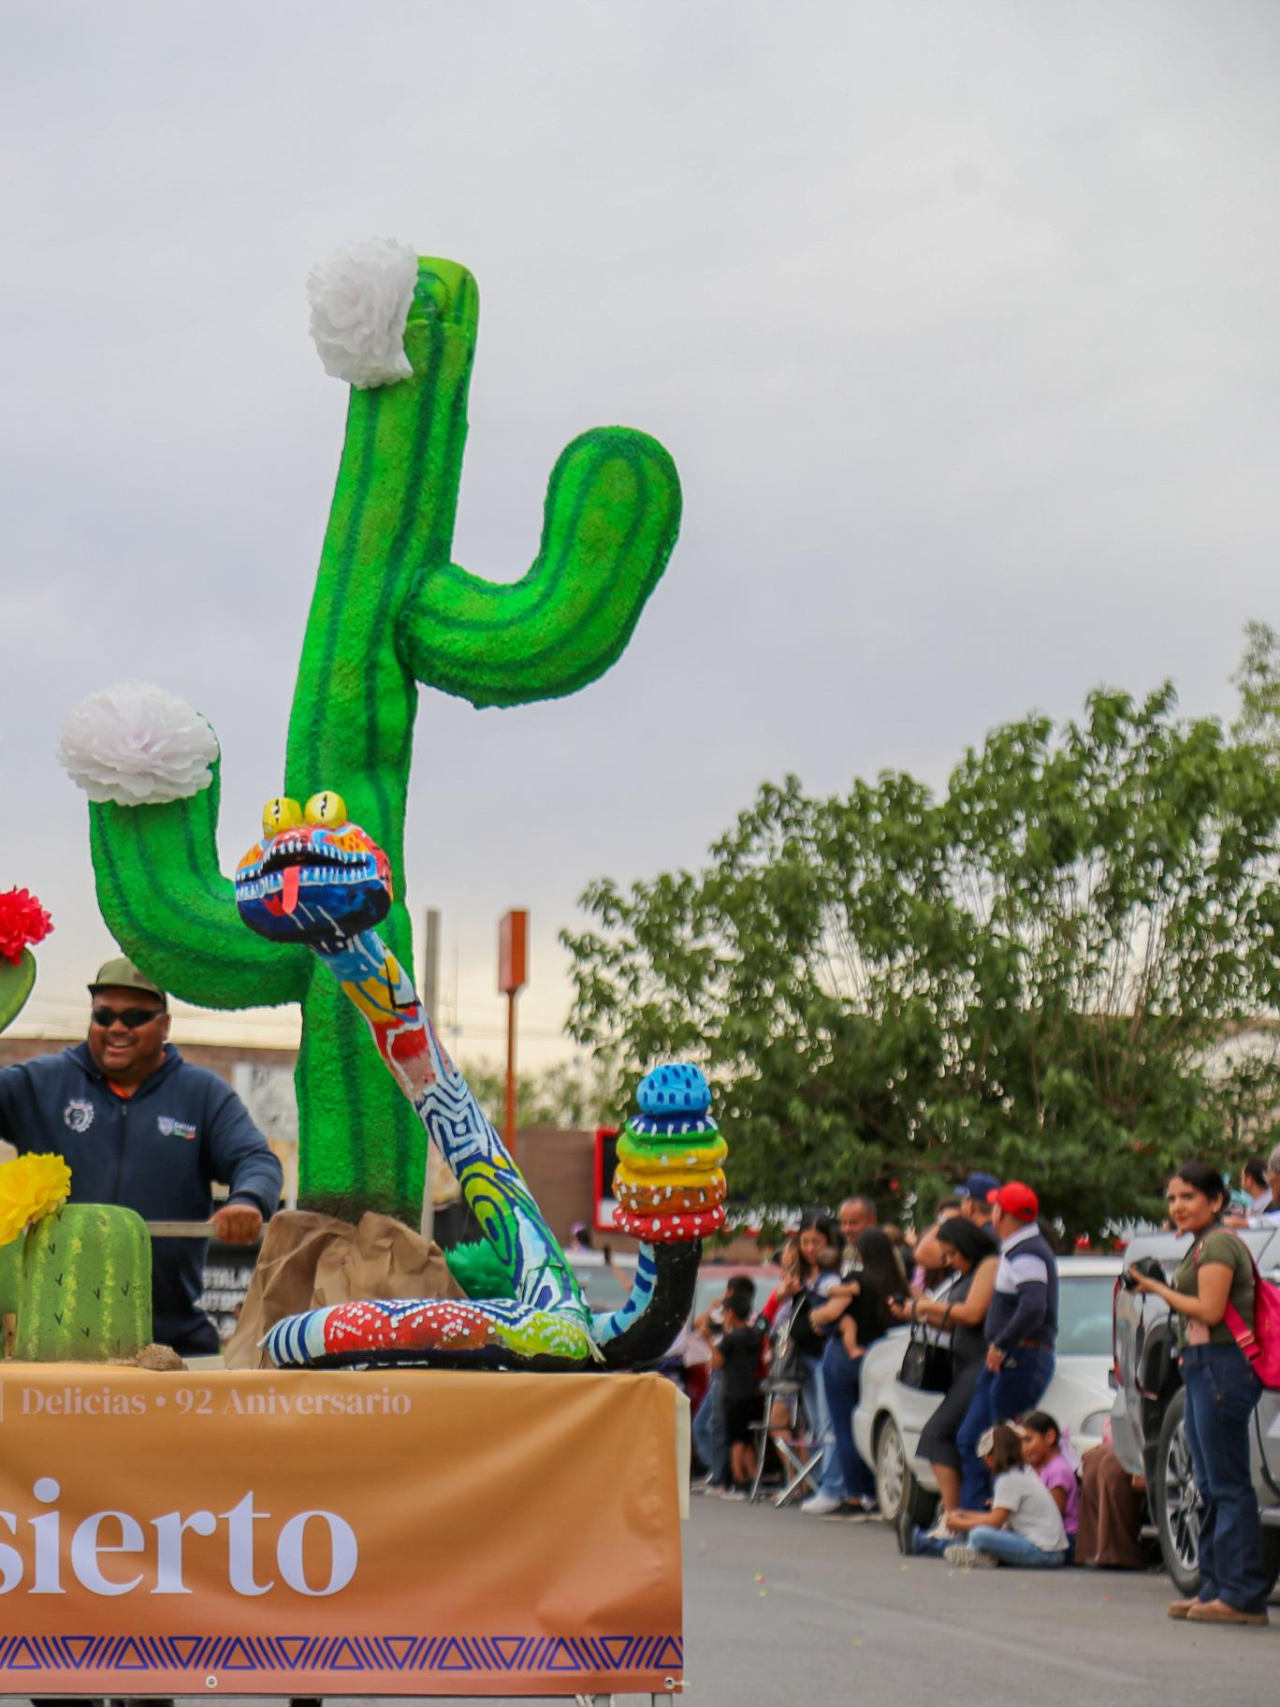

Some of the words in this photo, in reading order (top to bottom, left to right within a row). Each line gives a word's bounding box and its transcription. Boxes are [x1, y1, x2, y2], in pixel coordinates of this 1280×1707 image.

[22, 1387, 147, 1416] Delicias
[175, 1388, 213, 1415] 92
[222, 1387, 412, 1416] Aniversario
